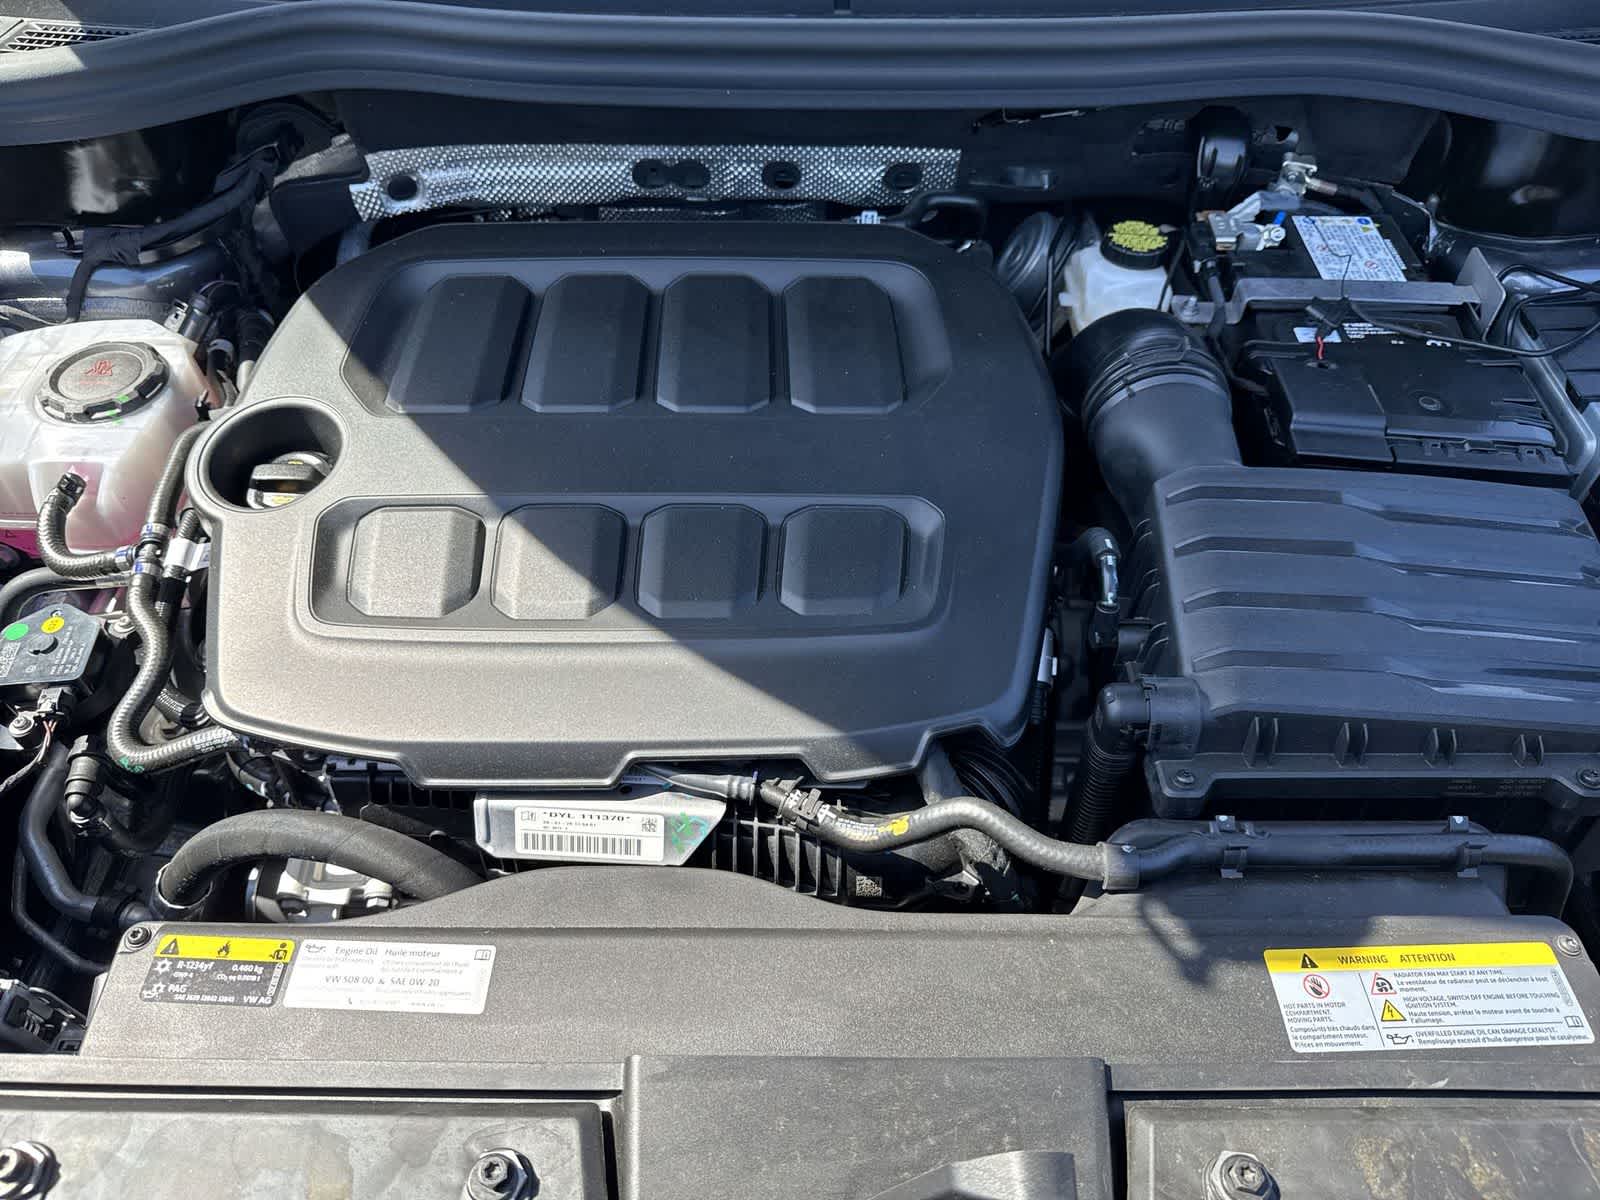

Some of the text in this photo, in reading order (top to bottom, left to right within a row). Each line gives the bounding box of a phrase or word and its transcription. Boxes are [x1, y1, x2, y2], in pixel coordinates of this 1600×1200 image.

[336, 946, 440, 958] Engine Oil Huile moteur
[1338, 953, 1456, 965] WARNING ATTENTION
[177, 961, 215, 972] R-1234yf
[254, 965, 264, 974] kg
[341, 976, 360, 984] 508
[362, 976, 374, 984] 00
[390, 977, 406, 986] SAE
[168, 984, 187, 992] PAG
[1299, 1033, 1343, 1041] compartiment
